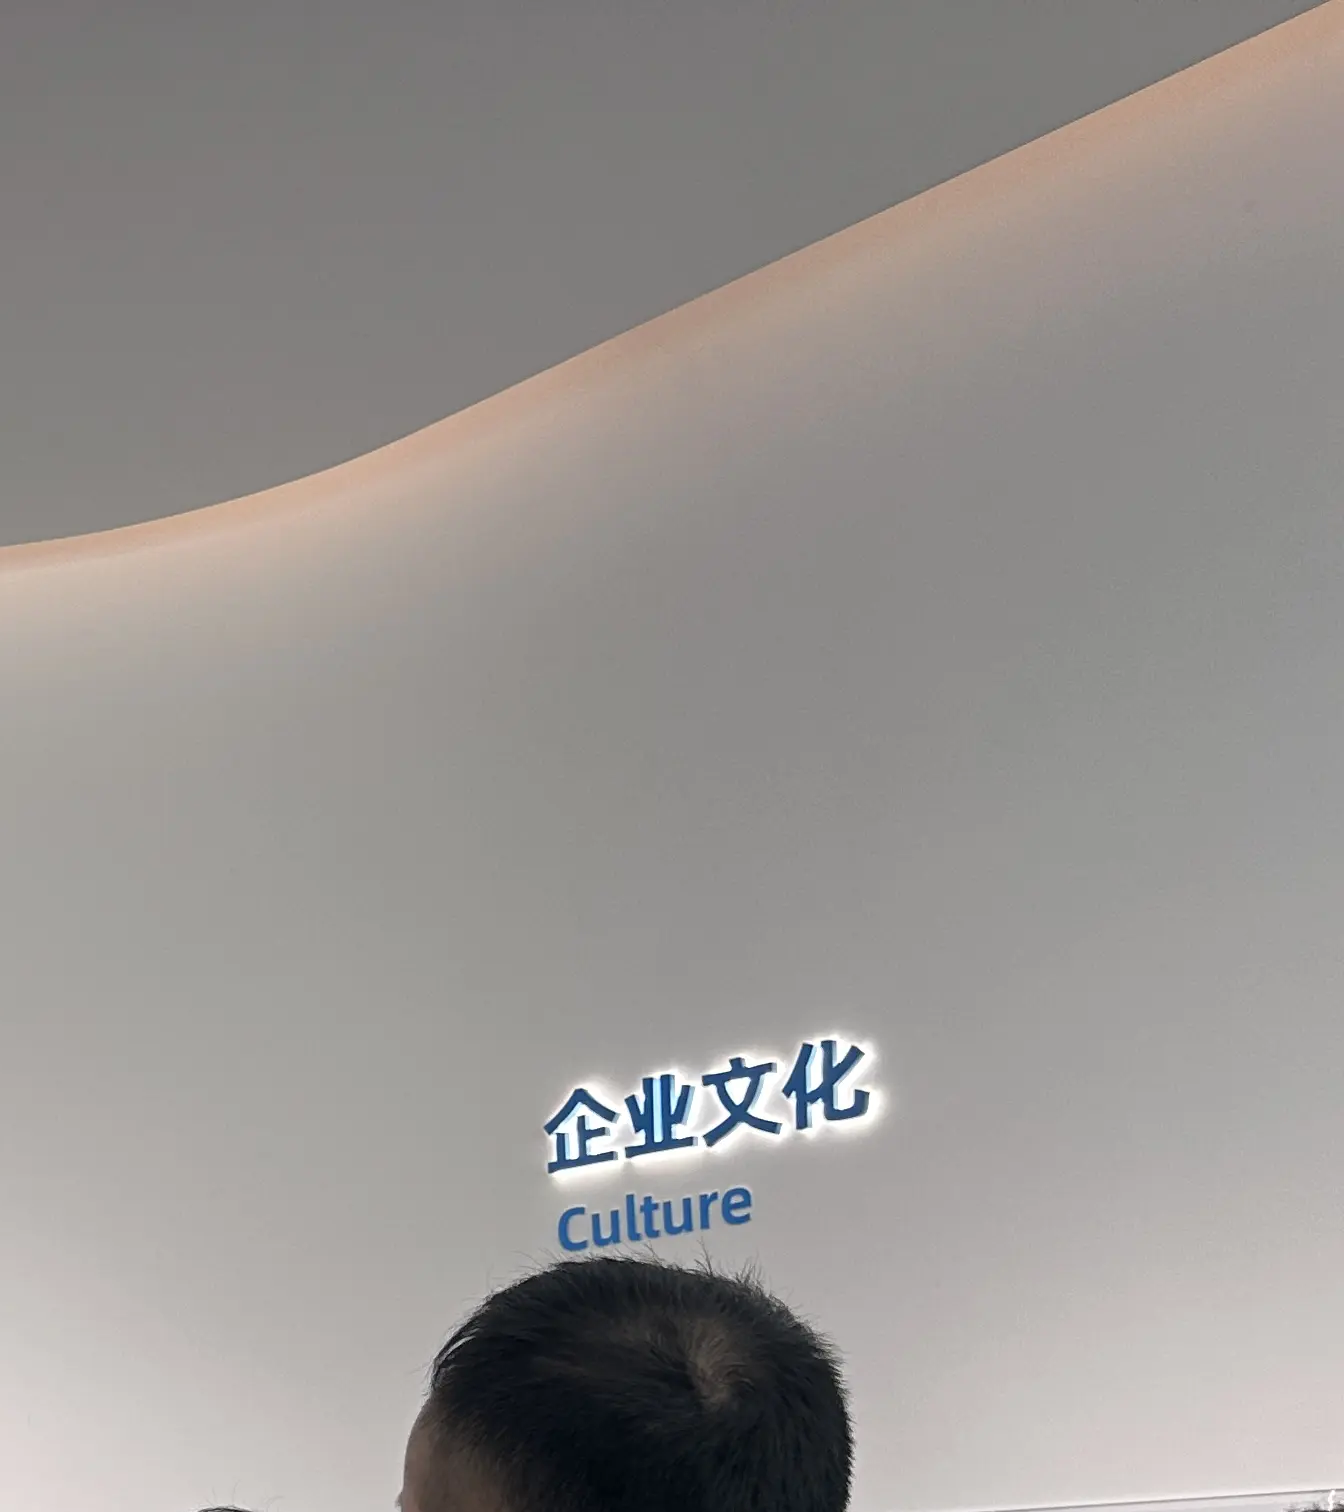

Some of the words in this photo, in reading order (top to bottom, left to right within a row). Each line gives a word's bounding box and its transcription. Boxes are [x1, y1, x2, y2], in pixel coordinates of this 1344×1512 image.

[544, 1040, 871, 1174] 企业文化
[557, 1186, 753, 1252] Culture
